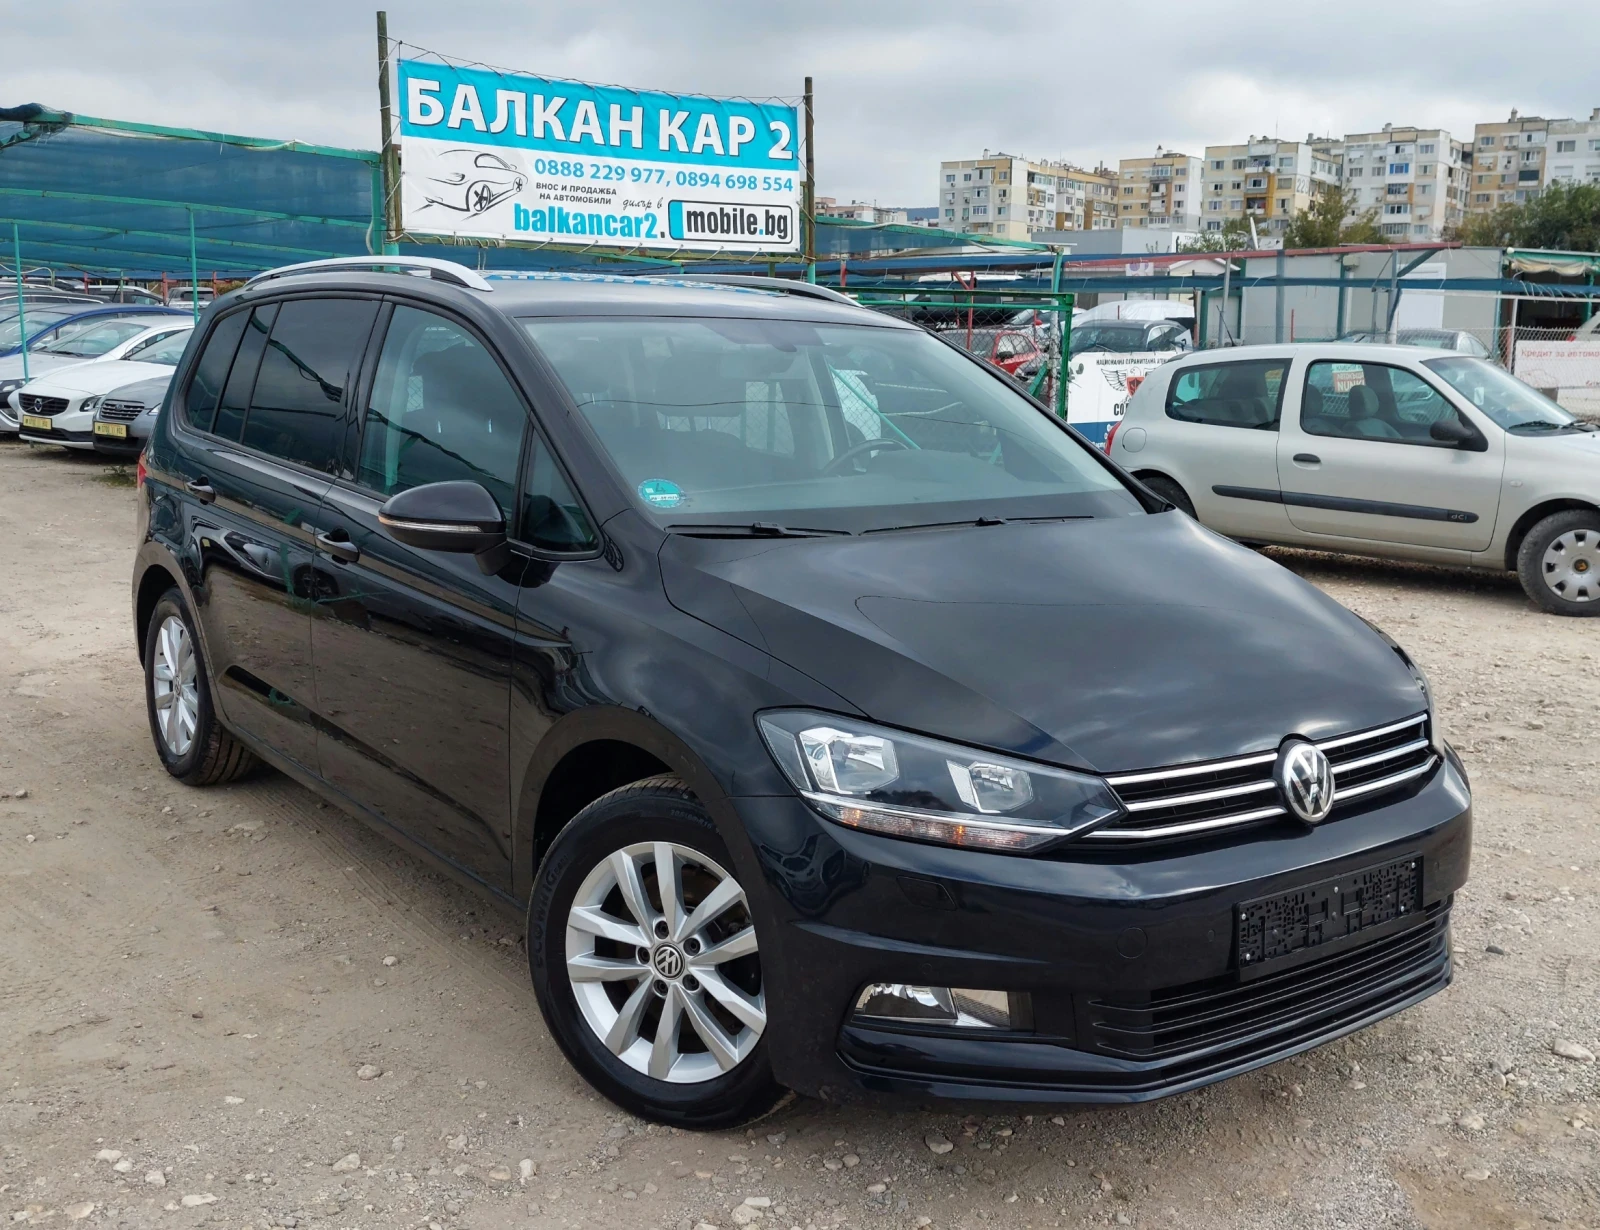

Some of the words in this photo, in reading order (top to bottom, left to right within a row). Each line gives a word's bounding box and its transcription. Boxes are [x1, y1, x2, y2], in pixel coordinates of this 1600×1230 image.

[407, 77, 643, 149] БАЛКАН
[658, 109, 756, 156] КАР
[768, 121, 793, 160] 2
[535, 158, 584, 178] 0888
[590, 163, 625, 181] 229
[675, 170, 721, 188] 0894
[725, 174, 757, 190] 698
[762, 177, 793, 192] 554
[536, 182, 558, 191] ВНОС
[569, 185, 617, 195] ПРОДАЖБА
[553, 194, 611, 205] АВТОМОБИЛИ
[686, 207, 788, 239] mobile.bg
